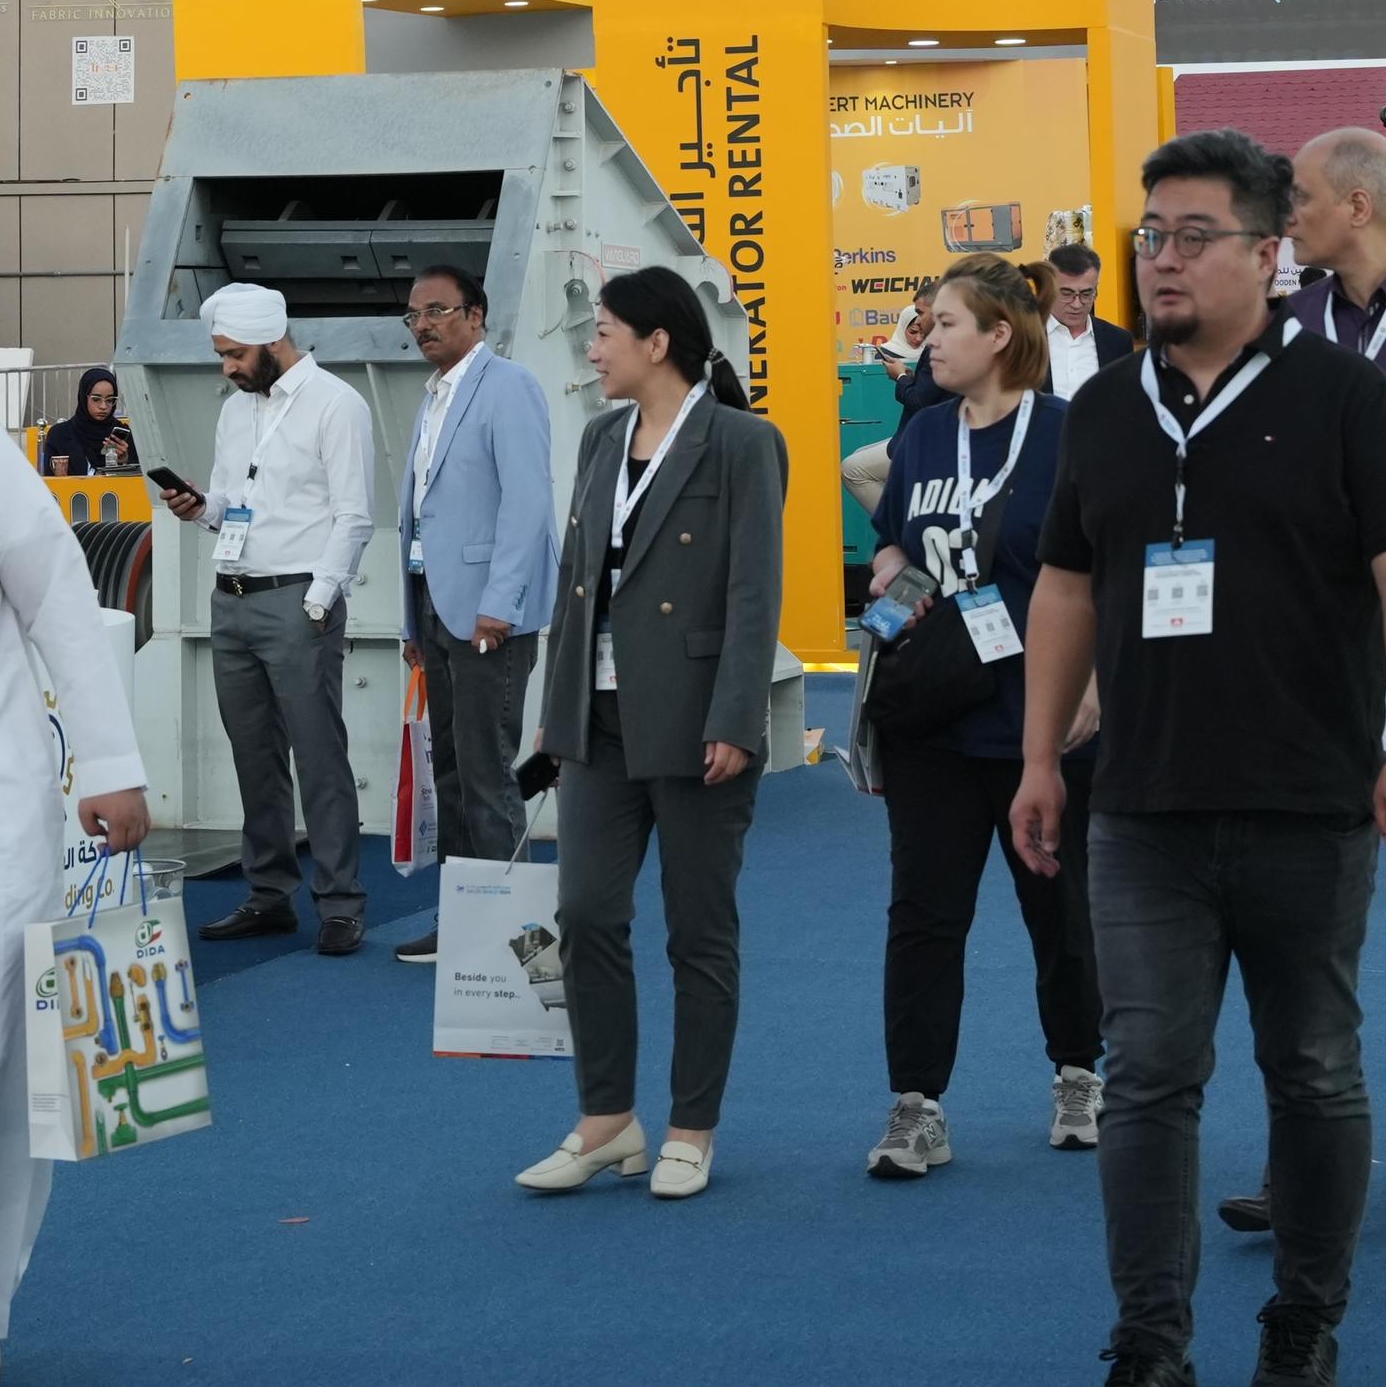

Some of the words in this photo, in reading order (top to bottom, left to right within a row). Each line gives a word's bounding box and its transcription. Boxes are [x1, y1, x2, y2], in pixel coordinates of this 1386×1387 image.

[31, 9, 82, 22] FABRIC
[88, 7, 171, 20] INNOVATIO
[829, 96, 859, 112] ERT
[864, 91, 975, 111] MACHINERY
[725, 34, 763, 198] RENTAL
[851, 275, 940, 294] WEICHA
[1274, 279, 1297, 287] OODEN
[729, 210, 769, 415] NERATOR
[136, 945, 166, 959] DIDA
[454, 971, 488, 983] Beside
[489, 974, 507, 984] you
[453, 989, 463, 997] in
[465, 989, 491, 1000] every
